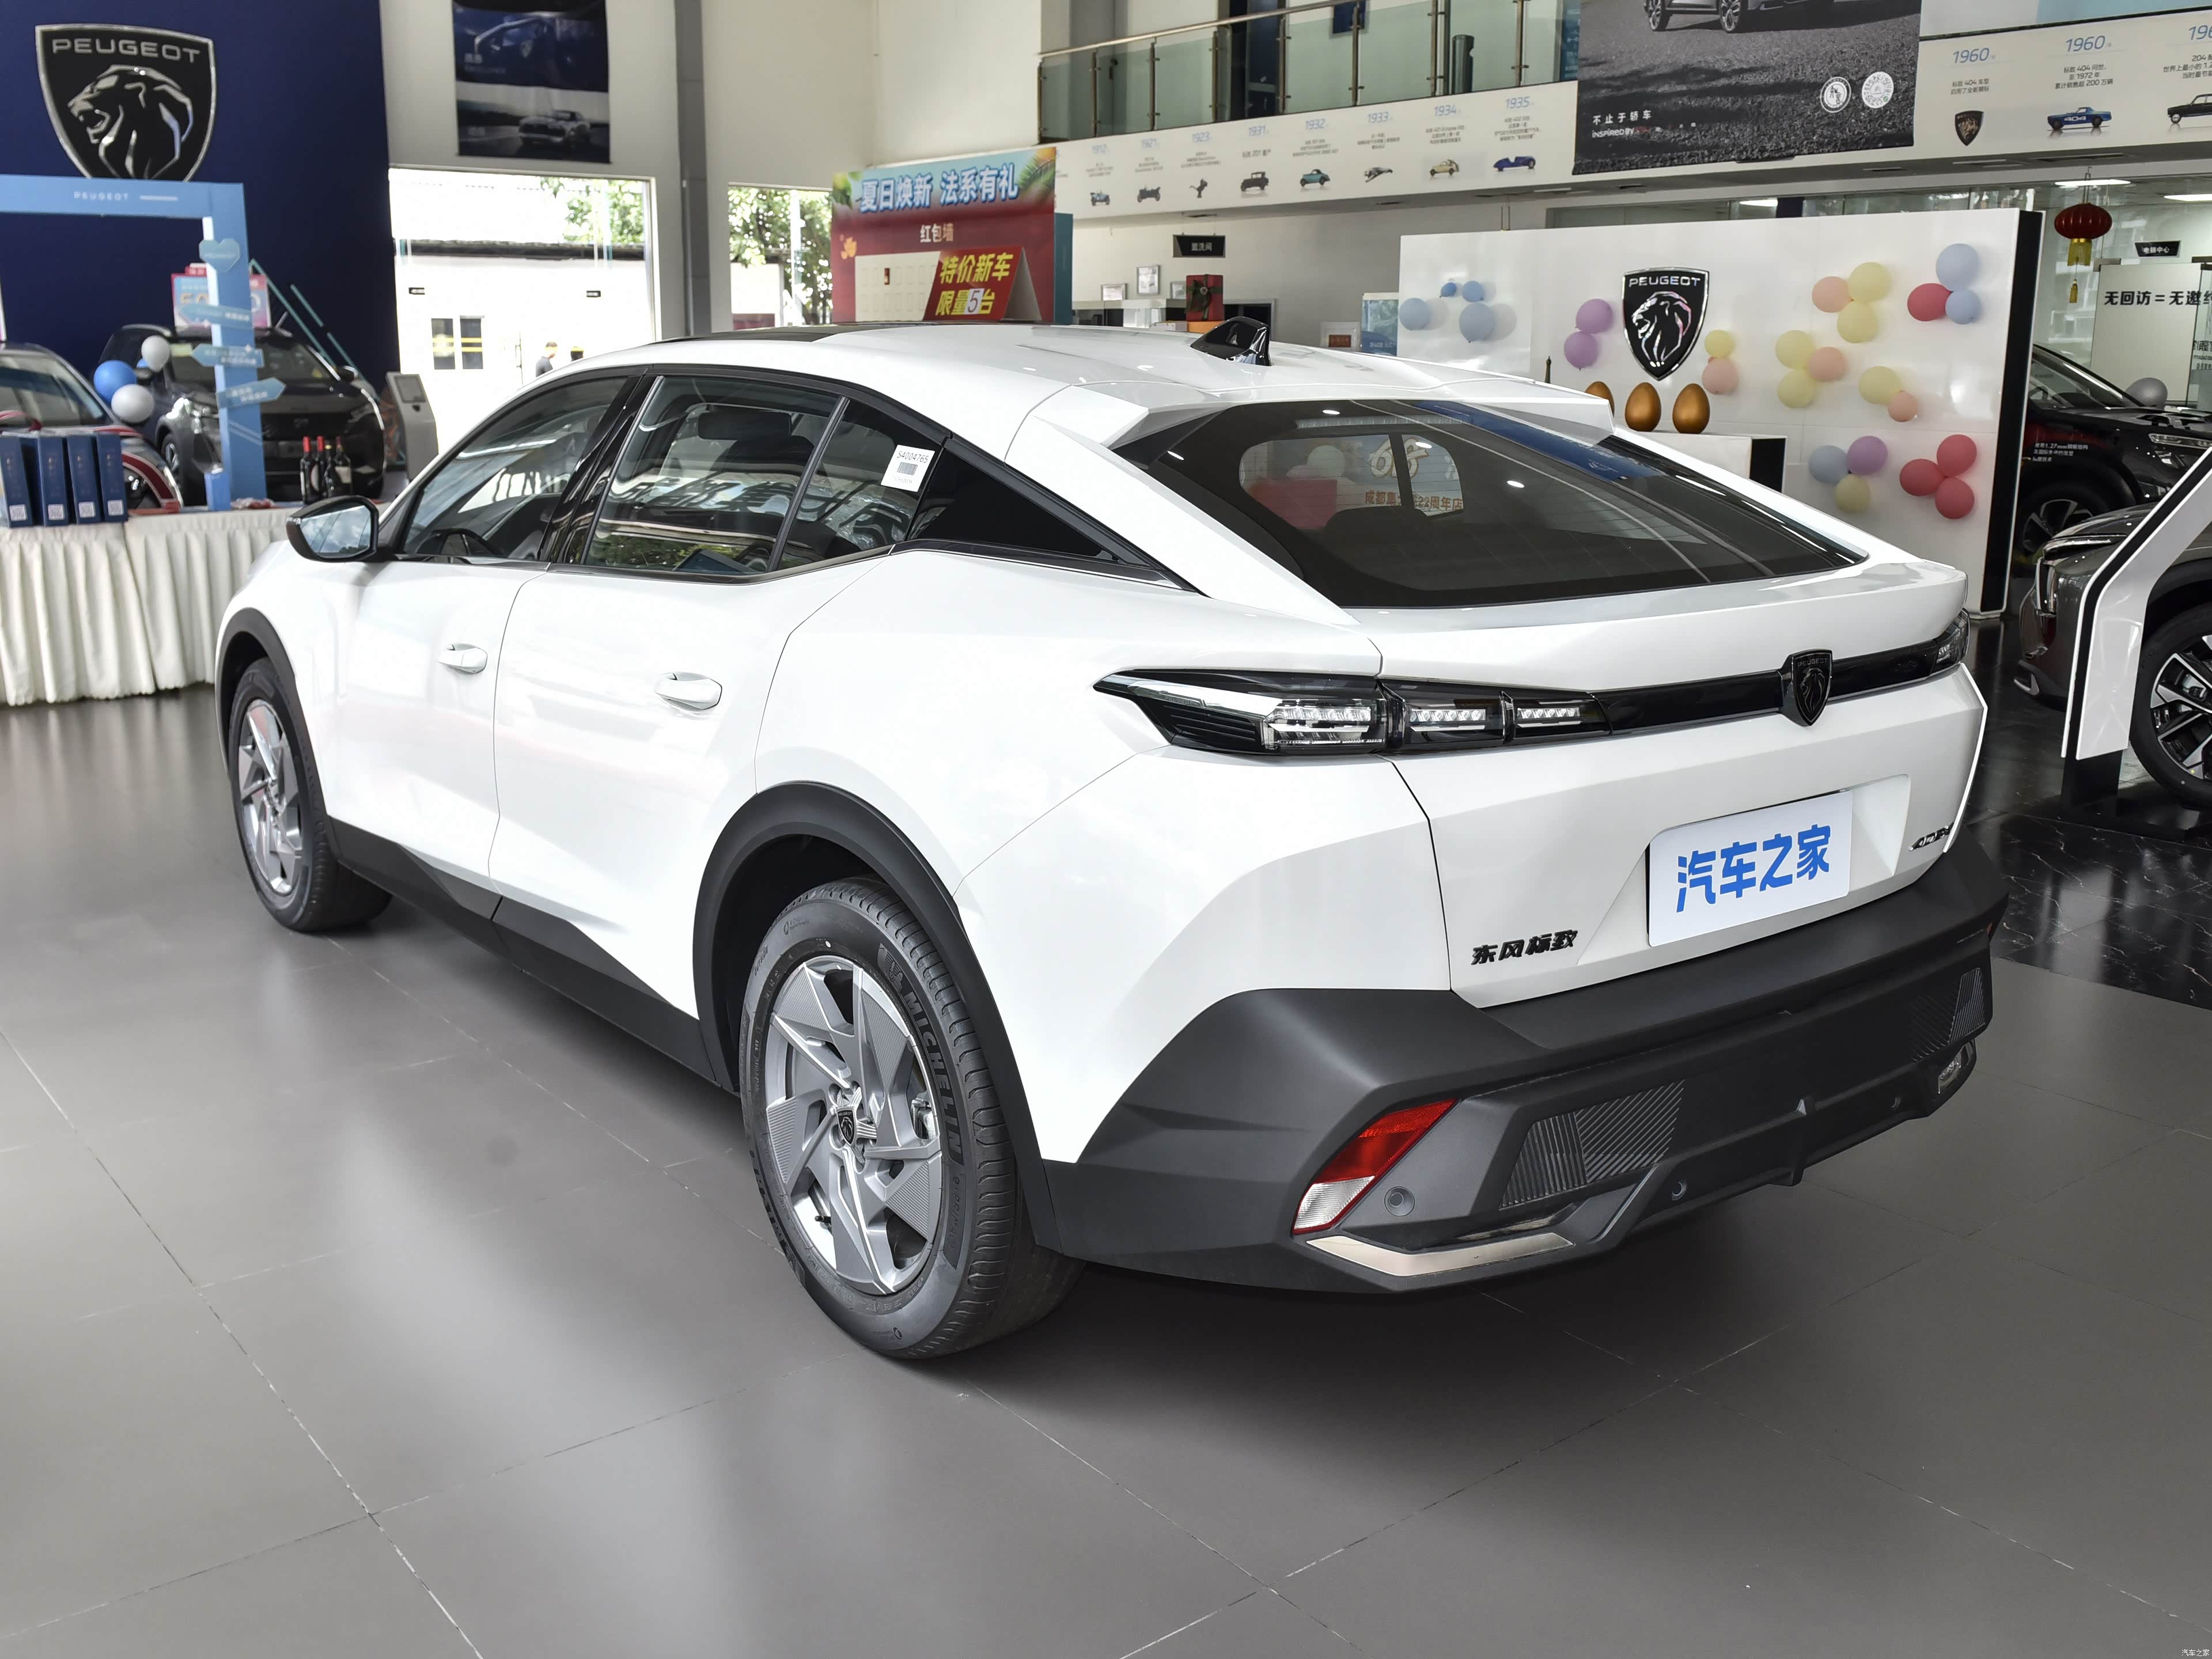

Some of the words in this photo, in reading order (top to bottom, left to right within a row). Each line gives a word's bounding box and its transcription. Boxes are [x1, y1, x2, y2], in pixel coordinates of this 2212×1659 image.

[52, 39, 200, 63] PEUGEOT
[2066, 35, 2105, 52] 1960
[1953, 47, 1990, 63] 1960
[1434, 104, 1456, 116] 1934
[1505, 96, 1530, 109] 1935
[1305, 119, 1325, 130] 1932
[1368, 111, 1389, 123] 1933
[1593, 110, 1652, 126] 不止于轿车
[74, 191, 129, 200] PEUGEOT
[859, 175, 933, 214] 夏日焕新
[940, 162, 1019, 206] 法系有礼
[920, 223, 954, 244] 红包墙
[940, 252, 1013, 284] 特价新车
[1628, 276, 1701, 287] PEUGEOT
[935, 289, 995, 316] 限量5台
[897, 450, 929, 463] S4004765
[1797, 658, 1828, 667] PEUGEOT
[1677, 824, 1831, 912] 汽车之家
[1471, 929, 1578, 965] 东风标致
[904, 991, 963, 1154] MICHELIN
